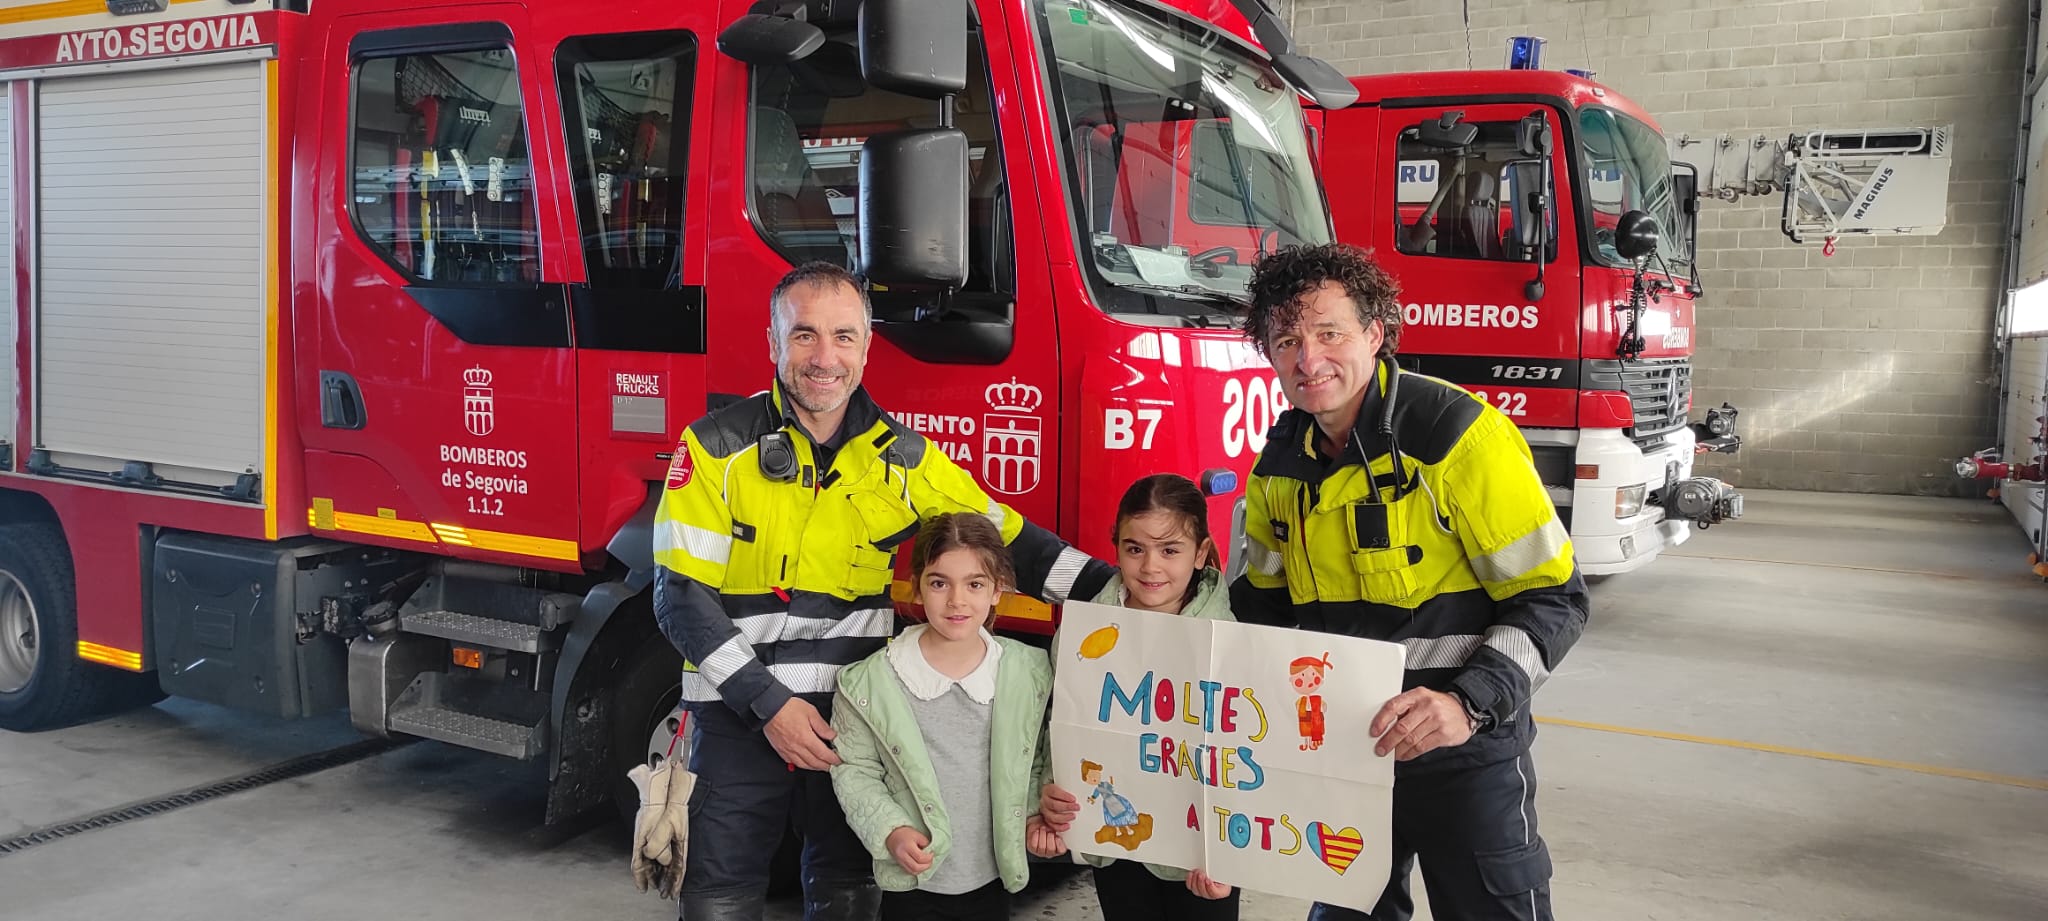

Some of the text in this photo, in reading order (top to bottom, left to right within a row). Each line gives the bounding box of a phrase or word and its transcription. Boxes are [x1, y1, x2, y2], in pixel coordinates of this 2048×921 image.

[56, 15, 260, 62] AYTO.SEGOVIA
[1853, 167, 1894, 220] MAGIRUS
[1395, 303, 1539, 329] OMBEROS
[616, 373, 659, 386] RENAULT
[1491, 365, 1563, 380] 1831
[617, 383, 660, 395] TRUCKS
[1104, 408, 1163, 450] B7
[440, 444, 528, 469] BOMBEROS
[441, 468, 528, 495] de Segovia
[467, 496, 504, 516] 1.1.2
[1098, 671, 1268, 742] MOLTES
[1139, 733, 1265, 791] GRACIES
[1186, 803, 1302, 856] A TOTS
